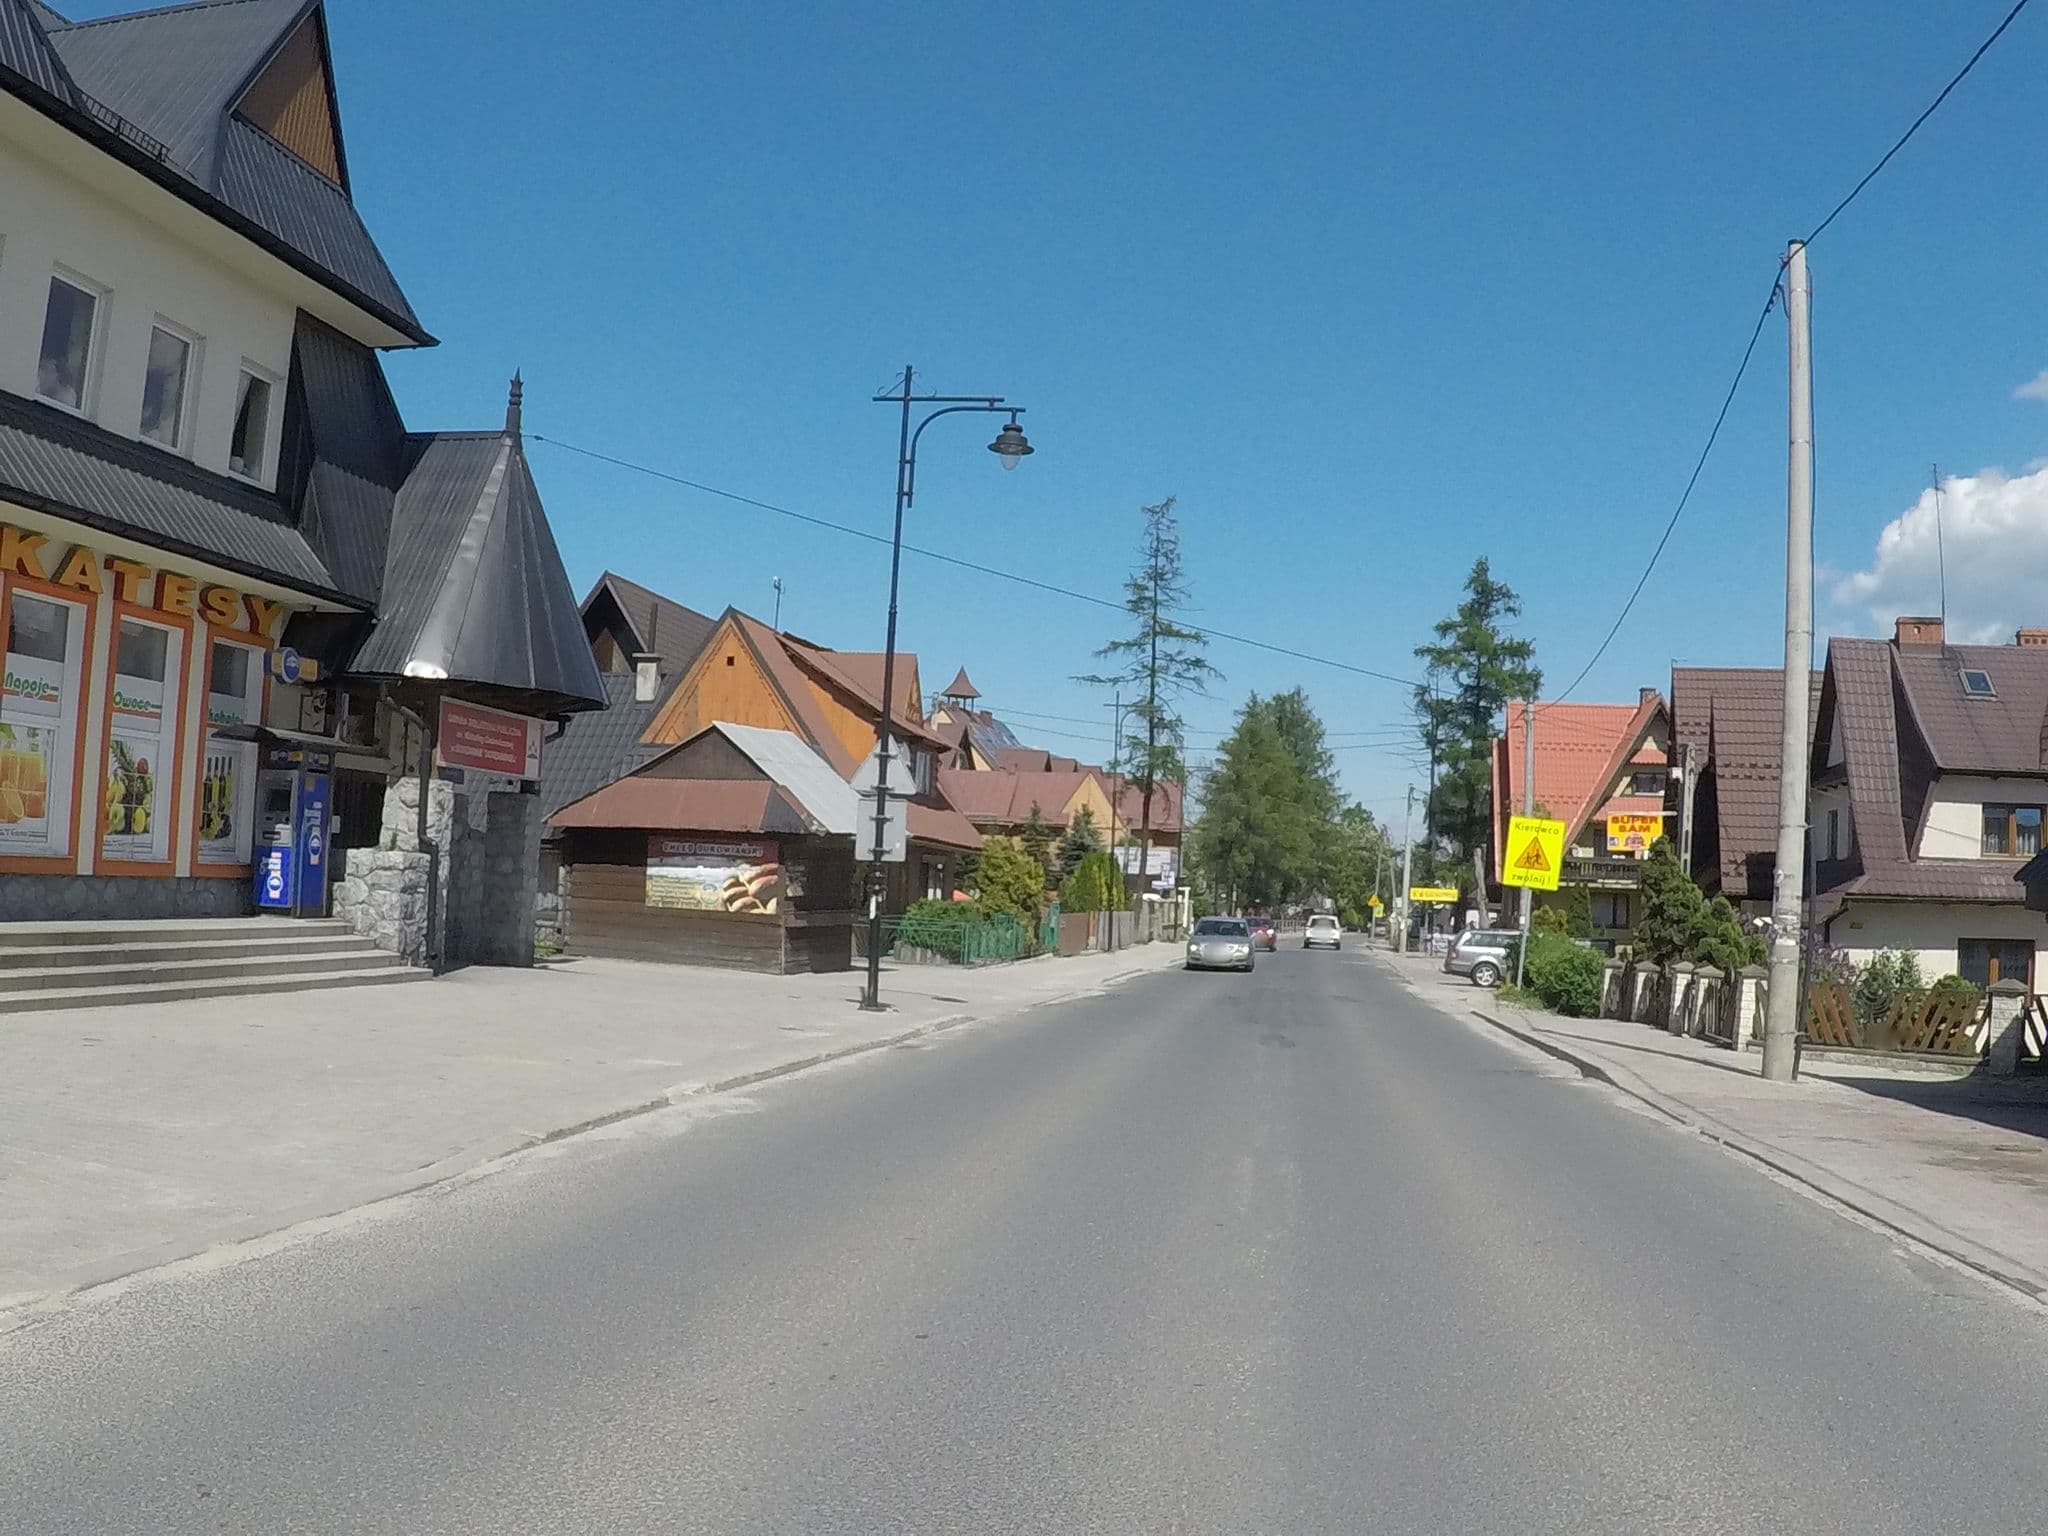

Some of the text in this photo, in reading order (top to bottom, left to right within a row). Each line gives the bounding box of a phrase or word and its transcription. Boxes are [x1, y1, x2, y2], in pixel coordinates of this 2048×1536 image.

[5, 671, 51, 697] Napoje
[113, 691, 151, 711] Owoce
[1611, 815, 1658, 825] SUPER
[1515, 822, 1560, 836] Kierowco
